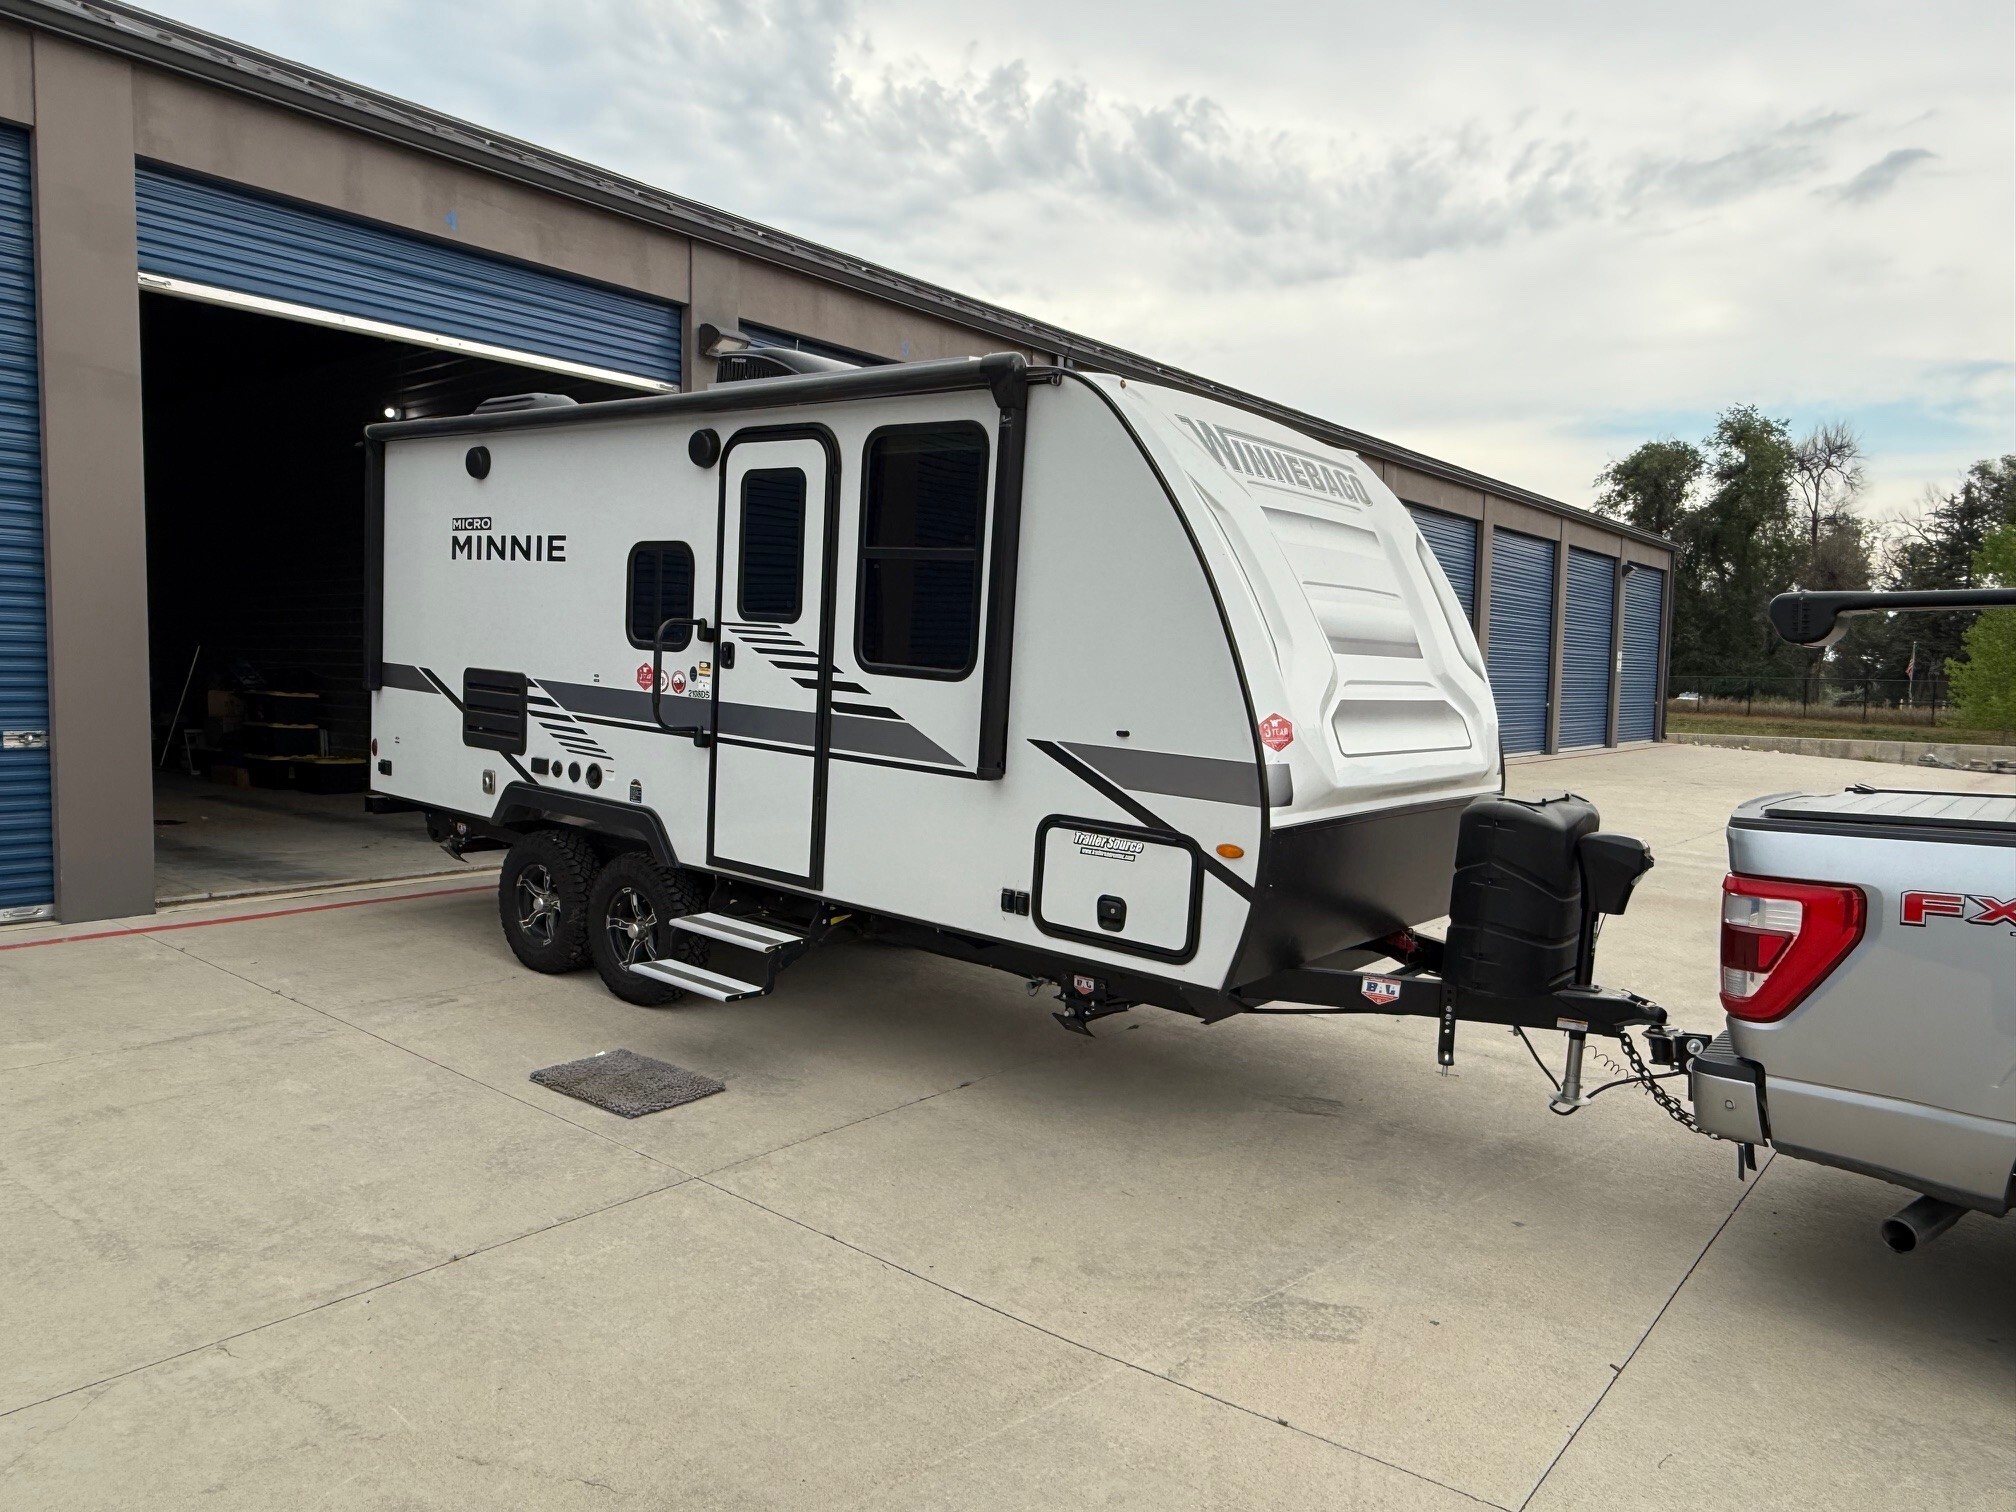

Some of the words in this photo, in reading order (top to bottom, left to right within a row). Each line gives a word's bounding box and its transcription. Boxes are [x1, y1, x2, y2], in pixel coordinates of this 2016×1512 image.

[1175, 414, 1374, 507] WINNEBAGO
[452, 518, 491, 530] MICRO
[452, 535, 567, 562] MINNIE
[1073, 831, 1107, 849] Trailer
[1106, 837, 1144, 854] Source
